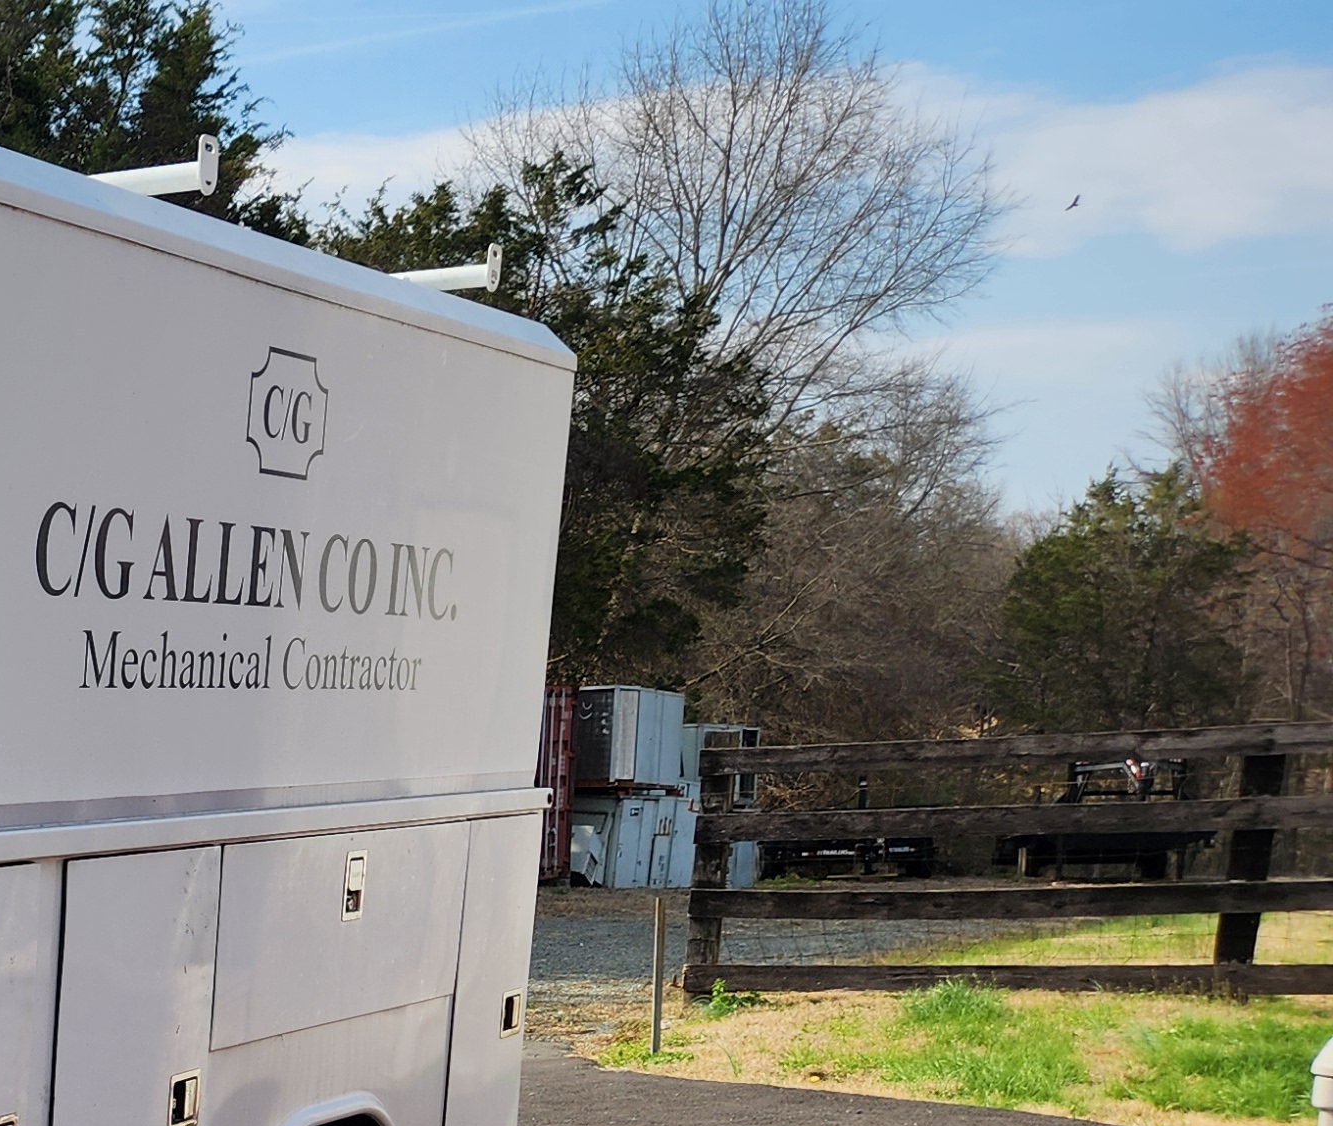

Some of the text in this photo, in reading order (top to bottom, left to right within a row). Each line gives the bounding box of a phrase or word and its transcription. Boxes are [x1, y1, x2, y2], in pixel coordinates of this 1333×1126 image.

[263, 384, 313, 445] C/G
[35, 501, 458, 621] C/G ALLEN CO INC.
[79, 629, 422, 691] Mechanical Contractor
